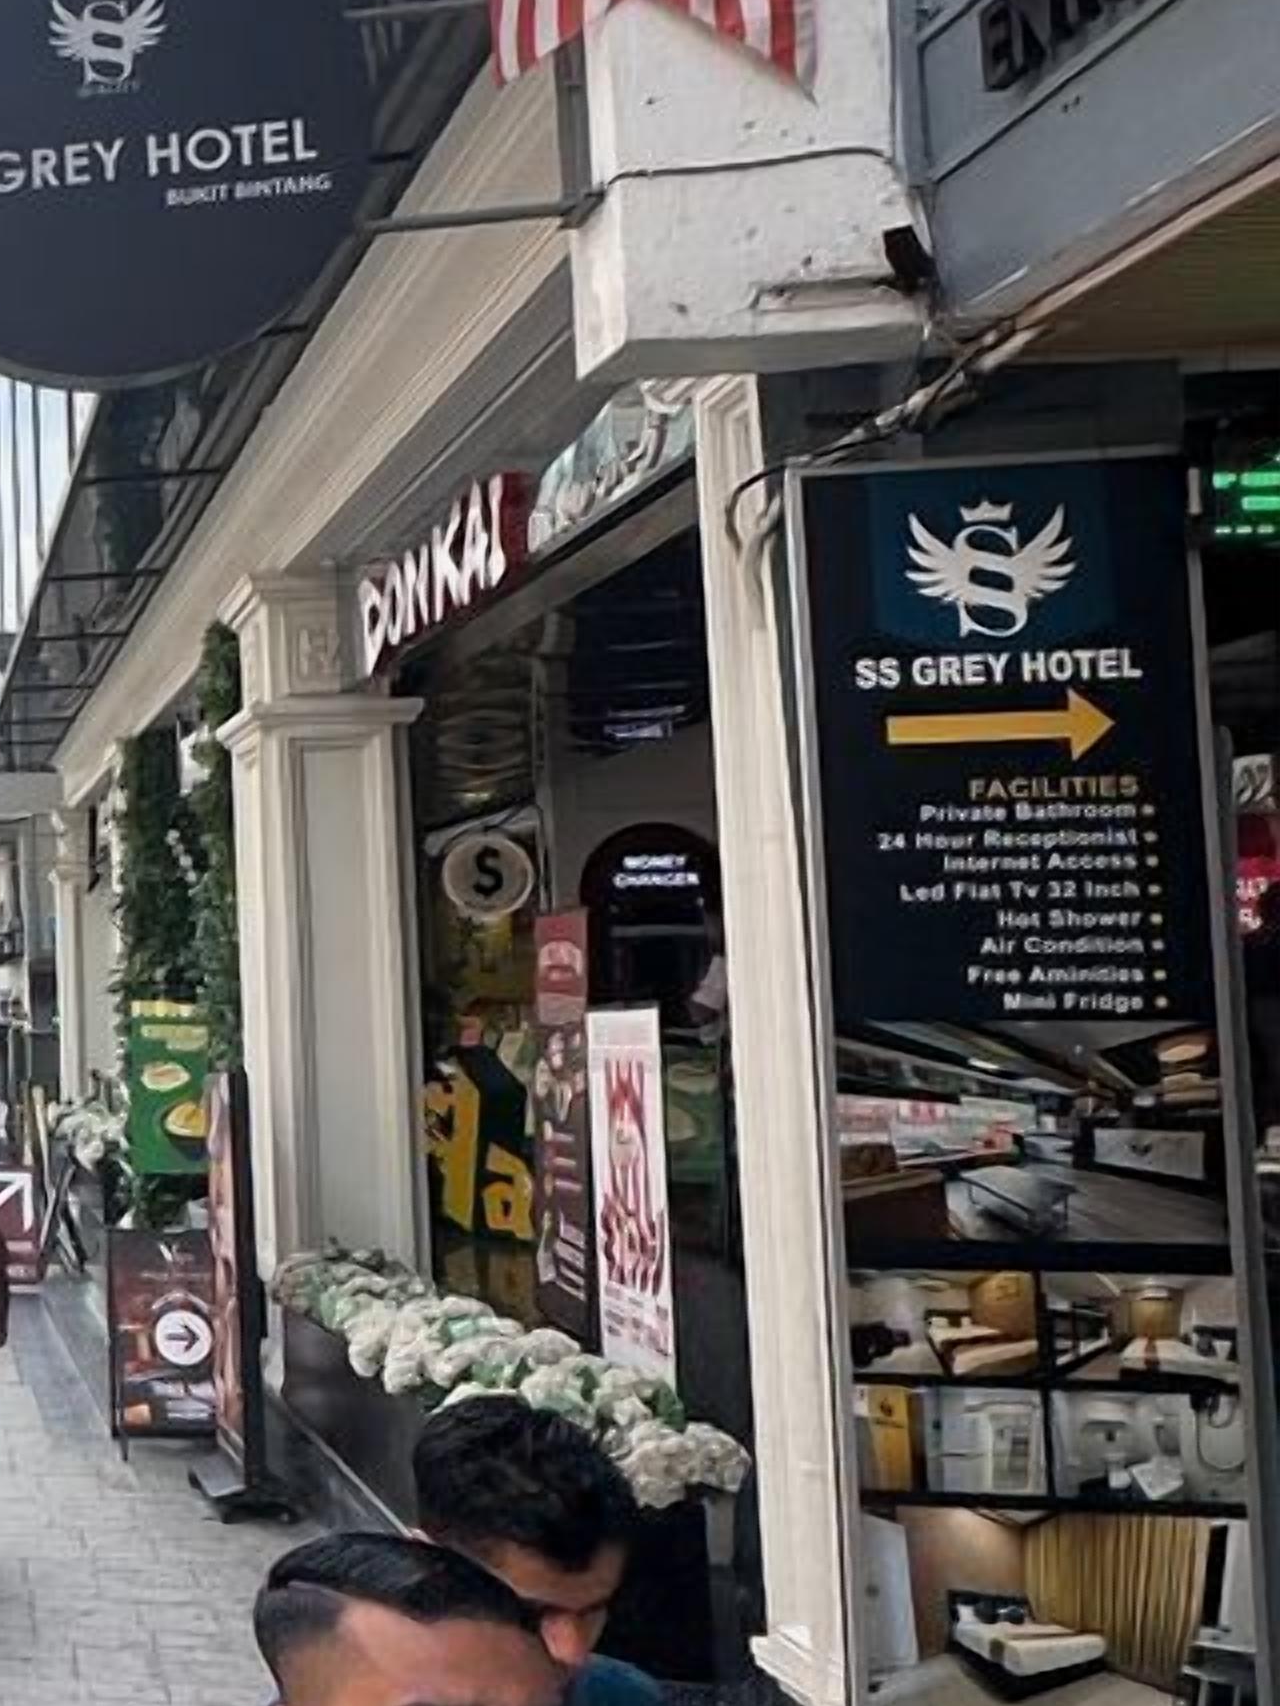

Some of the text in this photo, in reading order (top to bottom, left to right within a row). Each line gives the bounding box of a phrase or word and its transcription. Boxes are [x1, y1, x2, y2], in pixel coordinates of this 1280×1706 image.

[145, 117, 318, 177] HOTEL
[234, 172, 333, 201] BINTANG
[854, 648, 1143, 691] SS GREY HOTEL
[969, 775, 1139, 800] FACILITIES
[919, 801, 1137, 822] Private Bathroom
[877, 833, 906, 850] 24
[915, 832, 976, 849] Hour
[944, 852, 1138, 872] Internet Access
[899, 883, 945, 902] Led
[997, 908, 1142, 928] Hot Shower
[980, 936, 1144, 955] Air Condition
[967, 965, 1021, 984] Free
[1062, 991, 1144, 1014] Fridge
